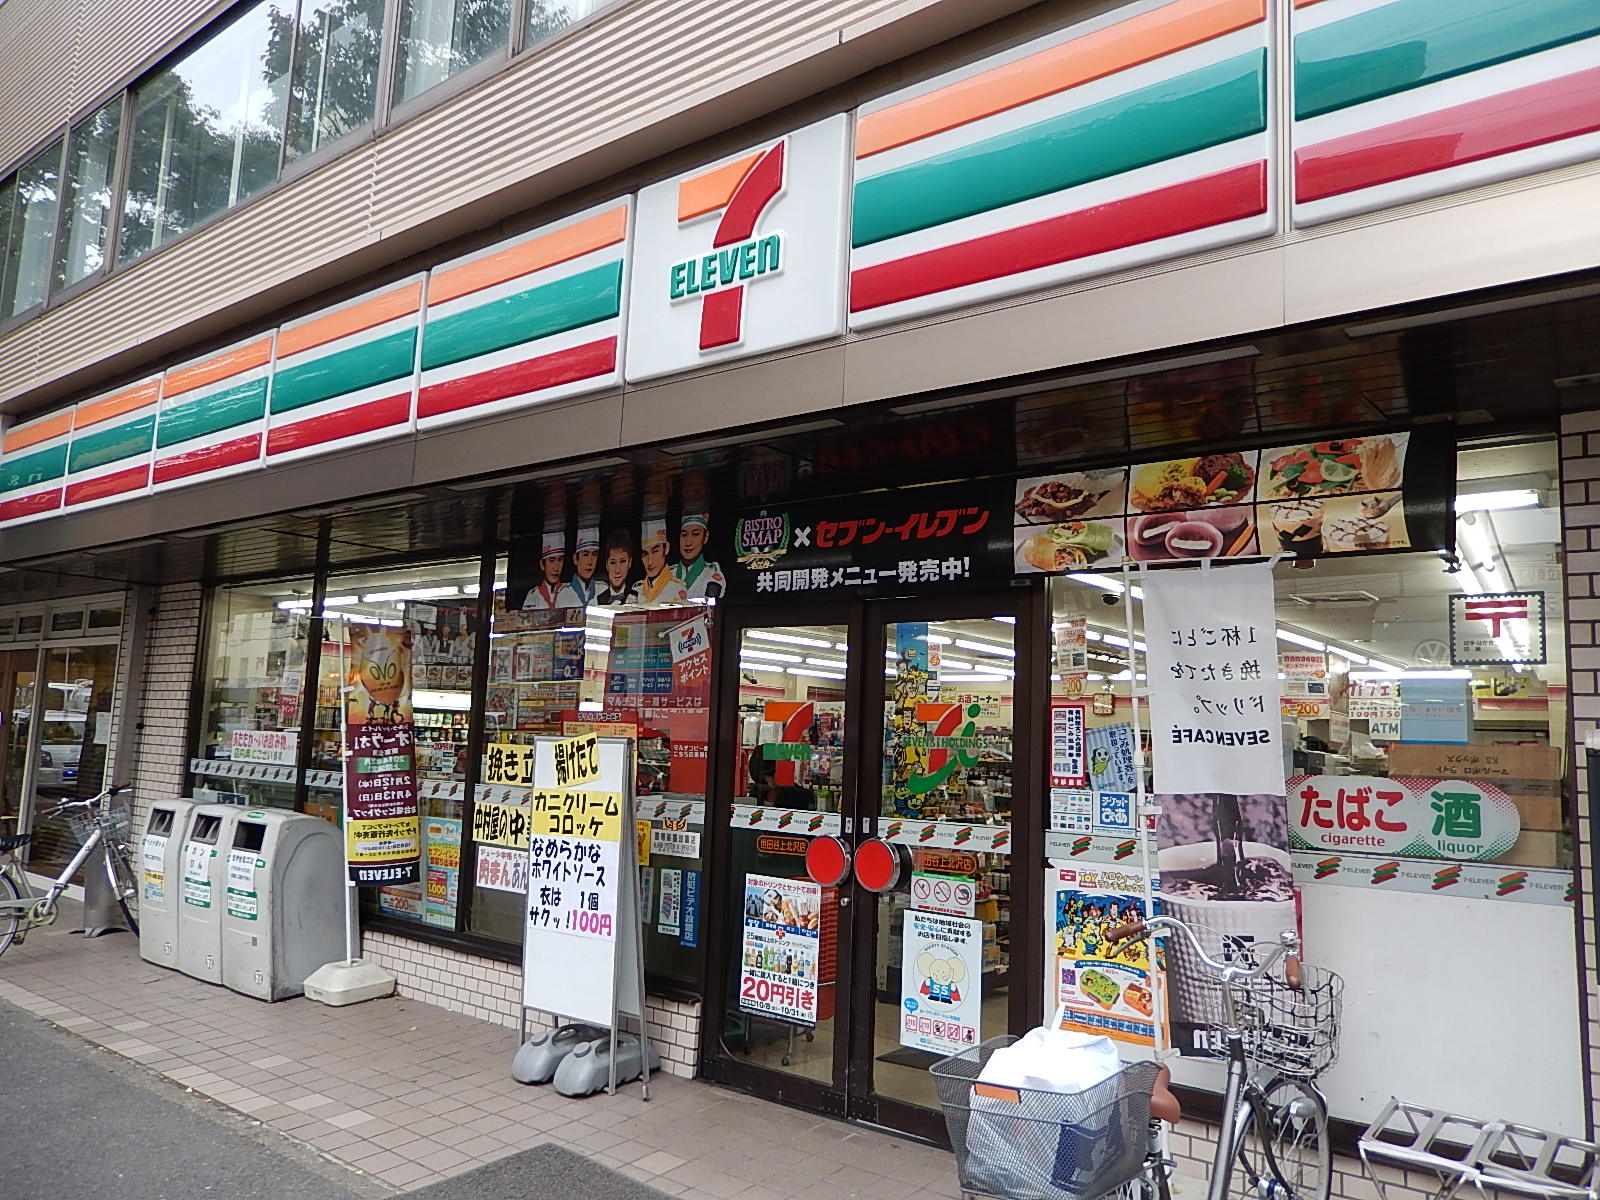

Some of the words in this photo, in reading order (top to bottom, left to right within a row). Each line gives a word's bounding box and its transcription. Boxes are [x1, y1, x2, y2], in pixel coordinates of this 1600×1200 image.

[677, 139, 784, 350] 7
[743, 516, 783, 532] BISTRO
[742, 529, 783, 547] SMAP
[756, 556, 970, 593] 共同開発メニュー発売中!
[678, 652, 708, 672] アクセス
[680, 664, 709, 684] ポイント
[1066, 677, 1082, 693] 200
[1297, 703, 1320, 715] 200
[1371, 722, 1399, 734] ATM
[942, 737, 989, 750] HOLDINGS
[554, 737, 599, 786] 揚げたて
[534, 791, 619, 816] カニクリーム
[1101, 796, 1129, 807] チケット
[1299, 784, 1408, 832] たばこ
[1101, 807, 1128, 824] ぴあ
[1430, 789, 1482, 839] 酒
[549, 814, 604, 837] コロッケ
[760, 838, 807, 853] 世田谷上北沢店
[1319, 832, 1386, 848] cigarette
[1437, 839, 1484, 855] liquor
[531, 837, 602, 864] なめらかな
[531, 858, 606, 888] ホワイトソース
[1078, 872, 1098, 882] TOY
[394, 898, 409, 911] 200
[539, 884, 562, 907] 衣は
[572, 909, 612, 937] 100円
[914, 914, 971, 929] 私たちは地域社会の
[742, 976, 814, 1011] 20円引き
[932, 984, 949, 996] SS
